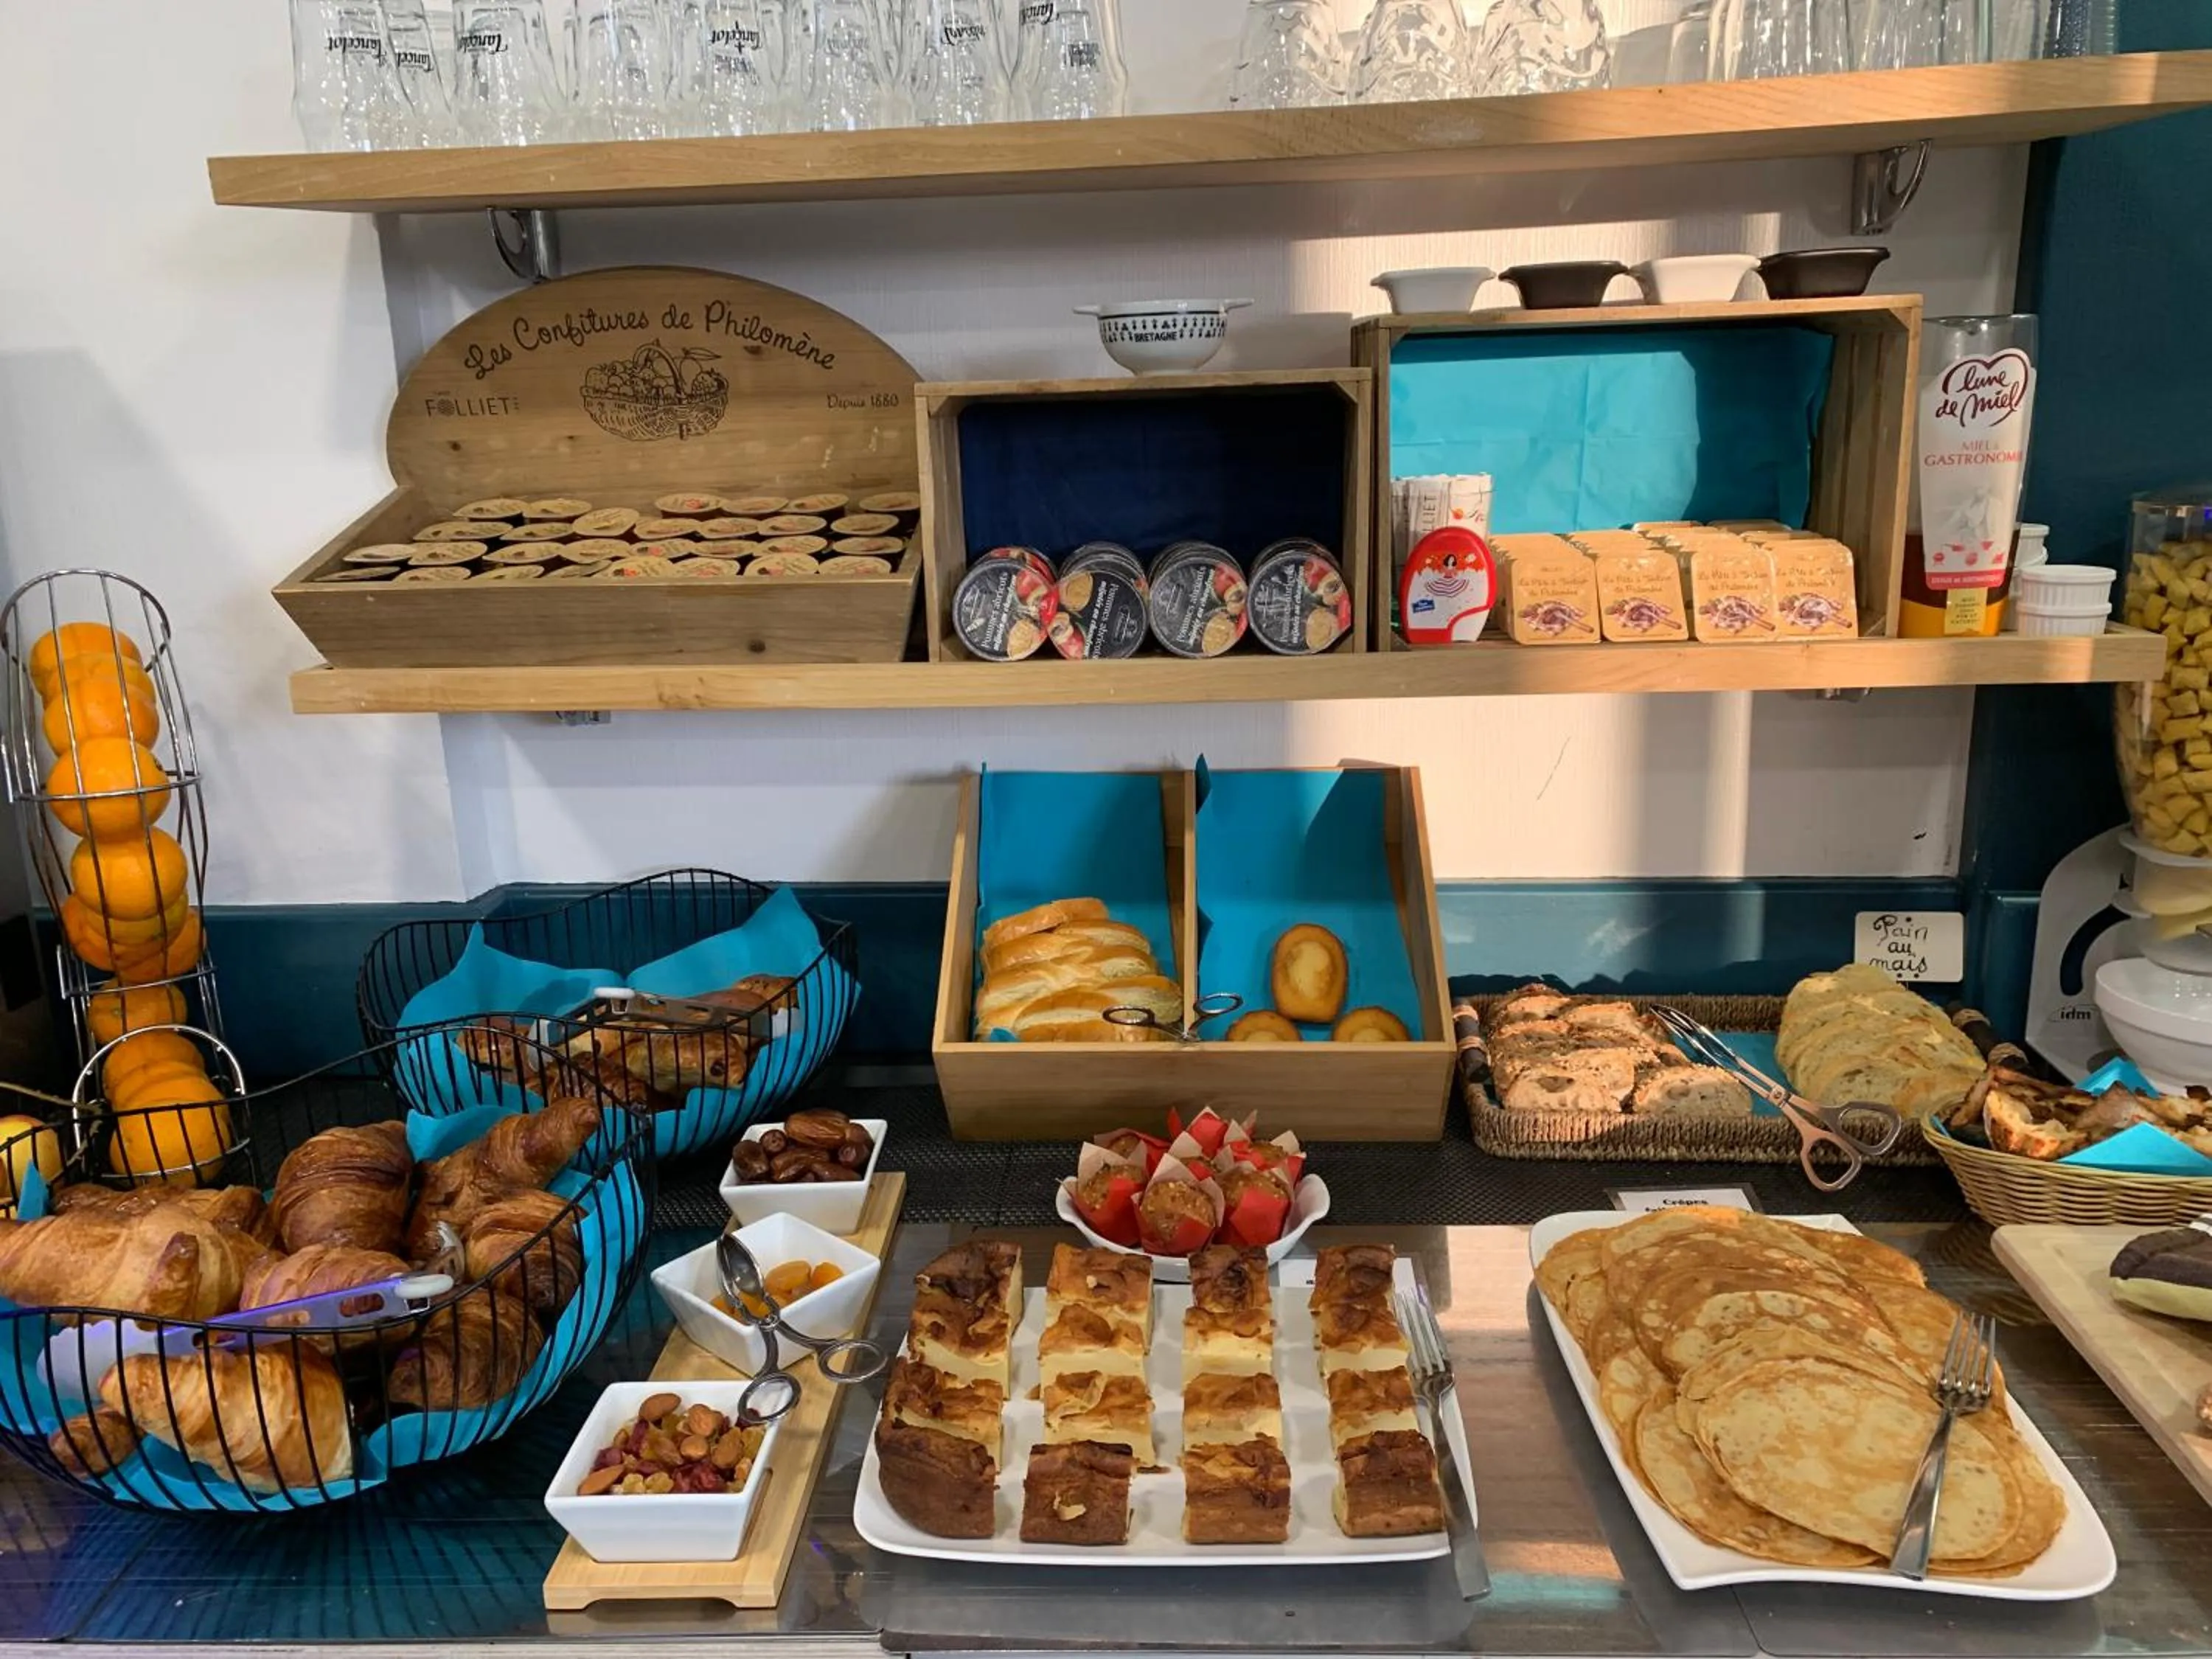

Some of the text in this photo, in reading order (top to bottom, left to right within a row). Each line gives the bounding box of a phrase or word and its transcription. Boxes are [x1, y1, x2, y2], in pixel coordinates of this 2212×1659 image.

[327, 36, 386, 60] Lancelot
[396, 51, 434, 72] Lancel
[465, 299, 835, 380] Les Confitures de Philomène
[1135, 332, 1177, 343] BRETAGNE
[827, 392, 865, 410] Depuis
[1935, 399, 1958, 418] de
[1421, 495, 1437, 533] LLIET
[1874, 914, 1928, 946] Pain
[1888, 942, 1911, 953] au
[2060, 1006, 2091, 1020] idm
